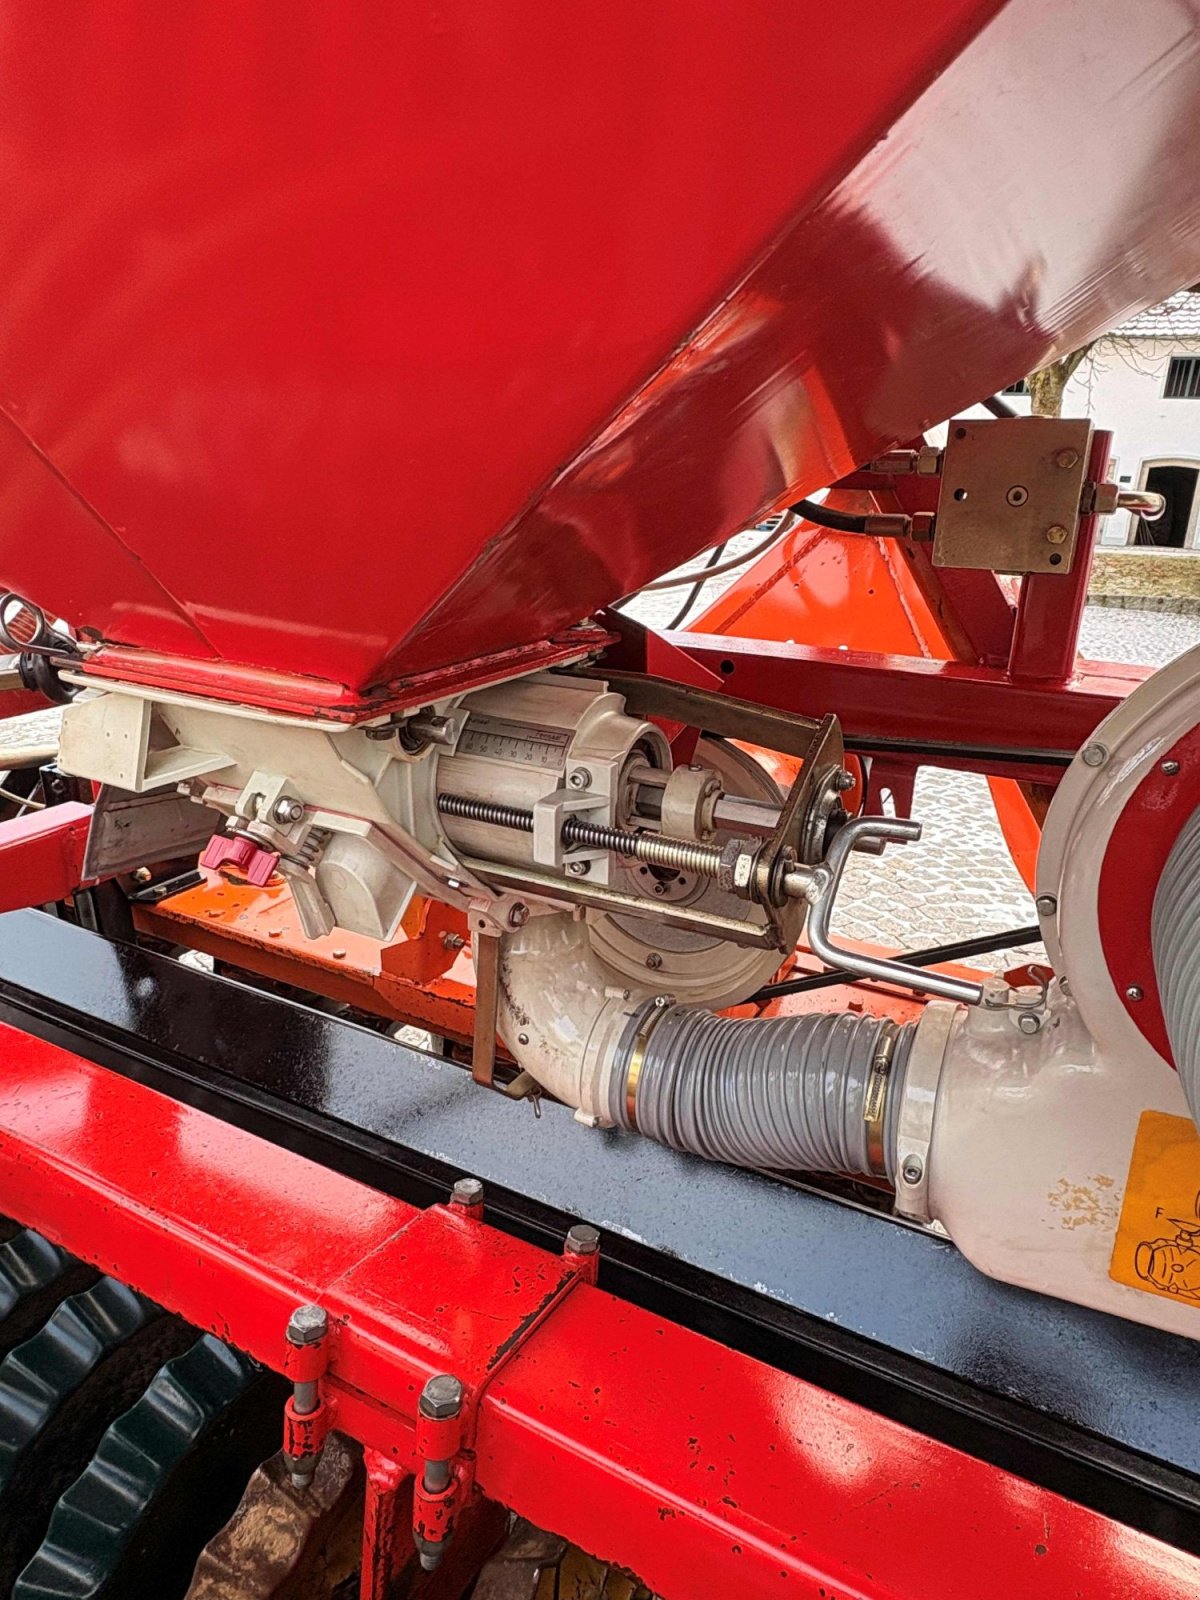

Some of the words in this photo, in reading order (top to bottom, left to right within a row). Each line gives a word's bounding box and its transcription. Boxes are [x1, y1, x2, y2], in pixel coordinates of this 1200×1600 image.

[479, 745, 488, 753] 50
[494, 749, 503, 757] 40
[524, 753, 533, 761] 20
[557, 758, 563, 766] 0
[1155, 1207, 1165, 1219] F
